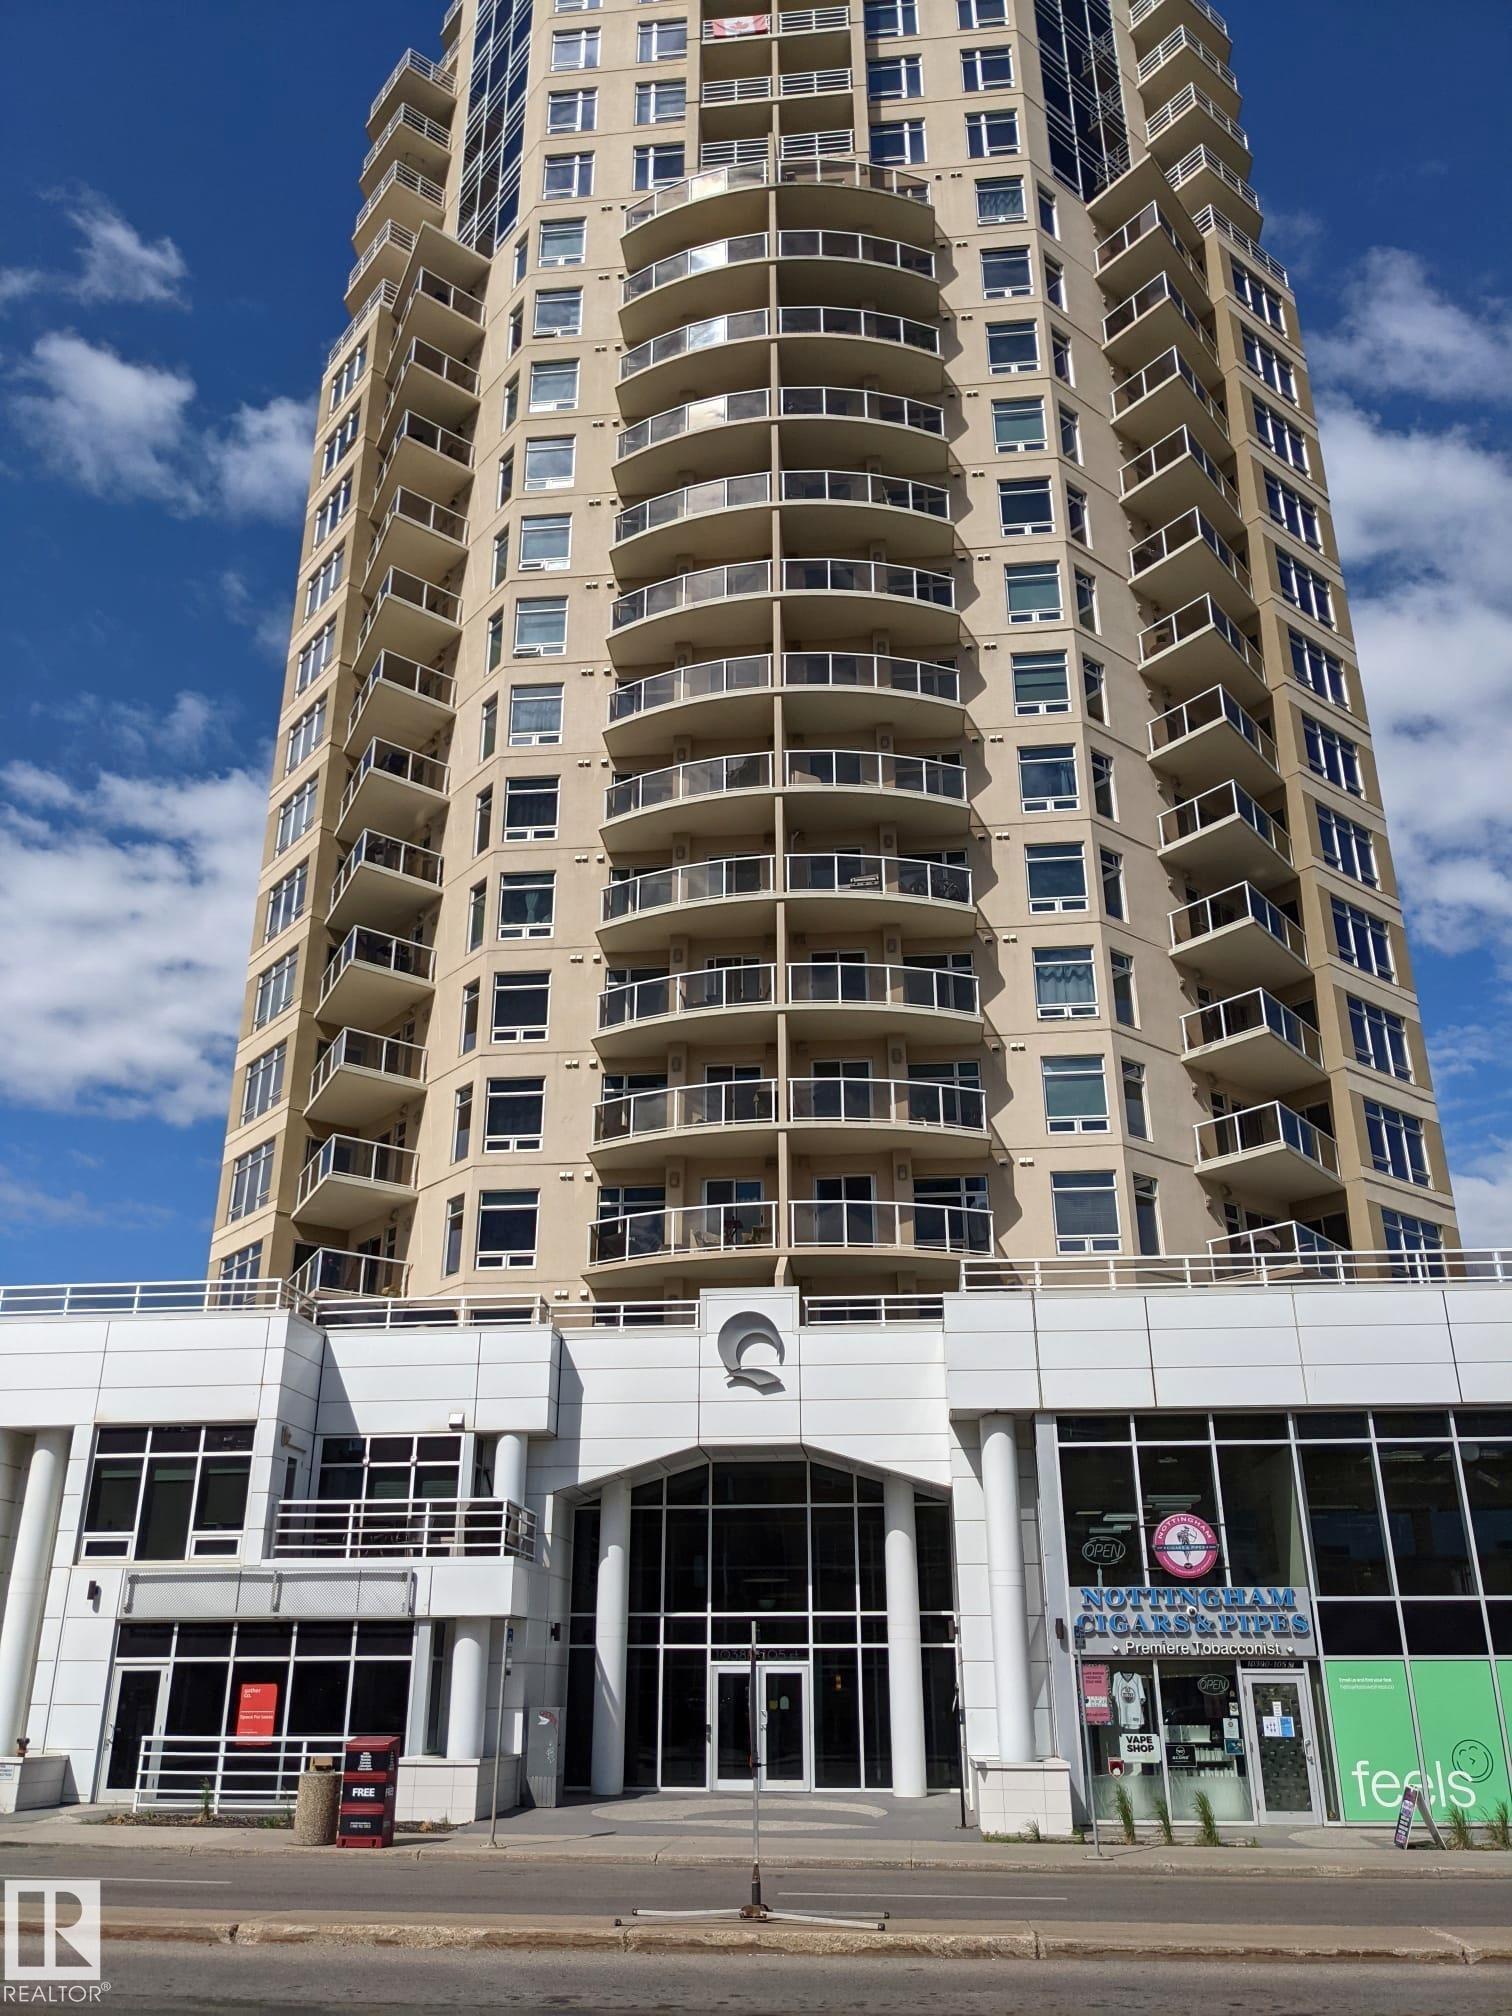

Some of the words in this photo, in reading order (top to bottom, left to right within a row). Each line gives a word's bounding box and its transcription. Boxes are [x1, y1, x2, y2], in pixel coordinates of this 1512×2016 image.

[1158, 1516, 1213, 1540] NOTTINGHAM
[1084, 1543, 1123, 1558] OPEN
[1081, 1587, 1296, 1608] NOTTINGHAM
[1125, 1641, 1189, 1655] Premiere
[1193, 1641, 1282, 1656] Tobacconist
[1199, 1679, 1227, 1691] OPEN
[1126, 1735, 1153, 1744] VAPE
[1127, 1744, 1155, 1753] SHOP
[352, 1787, 376, 1797] FREE
